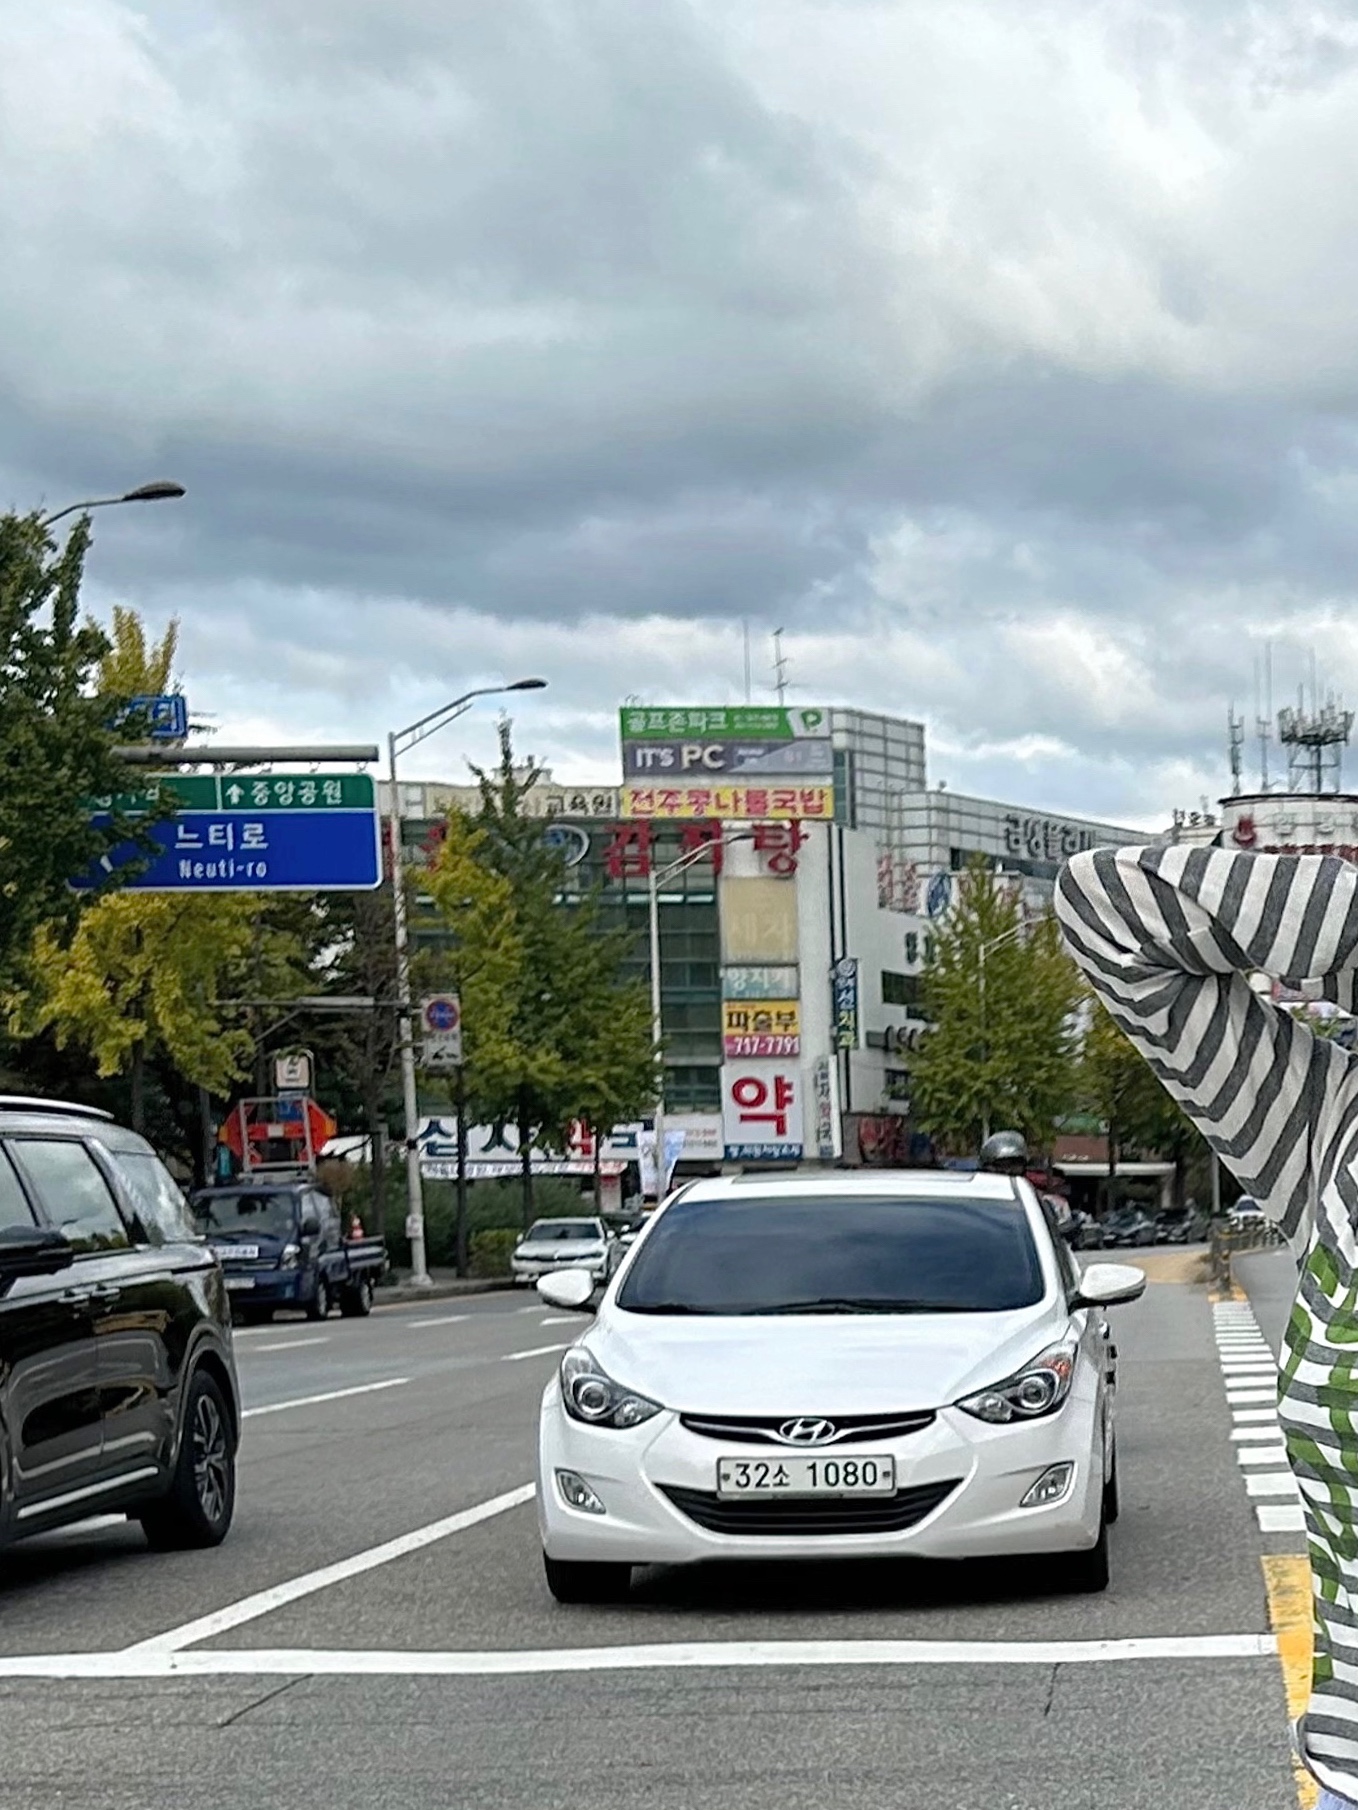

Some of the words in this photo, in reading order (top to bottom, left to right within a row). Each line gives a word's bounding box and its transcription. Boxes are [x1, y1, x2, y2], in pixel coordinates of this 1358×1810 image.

[636, 748, 674, 768] IT'S
[681, 745, 726, 769] PC
[251, 780, 342, 805] 중앙공원
[628, 788, 827, 816] 전주콩나물국밥
[174, 823, 268, 851] 느티로
[178, 858, 267, 880] Neuti-ro
[727, 1010, 797, 1032] 파출부
[732, 1075, 794, 1136] 약
[735, 1463, 790, 1488] 32소
[806, 1461, 877, 1487] 1080
